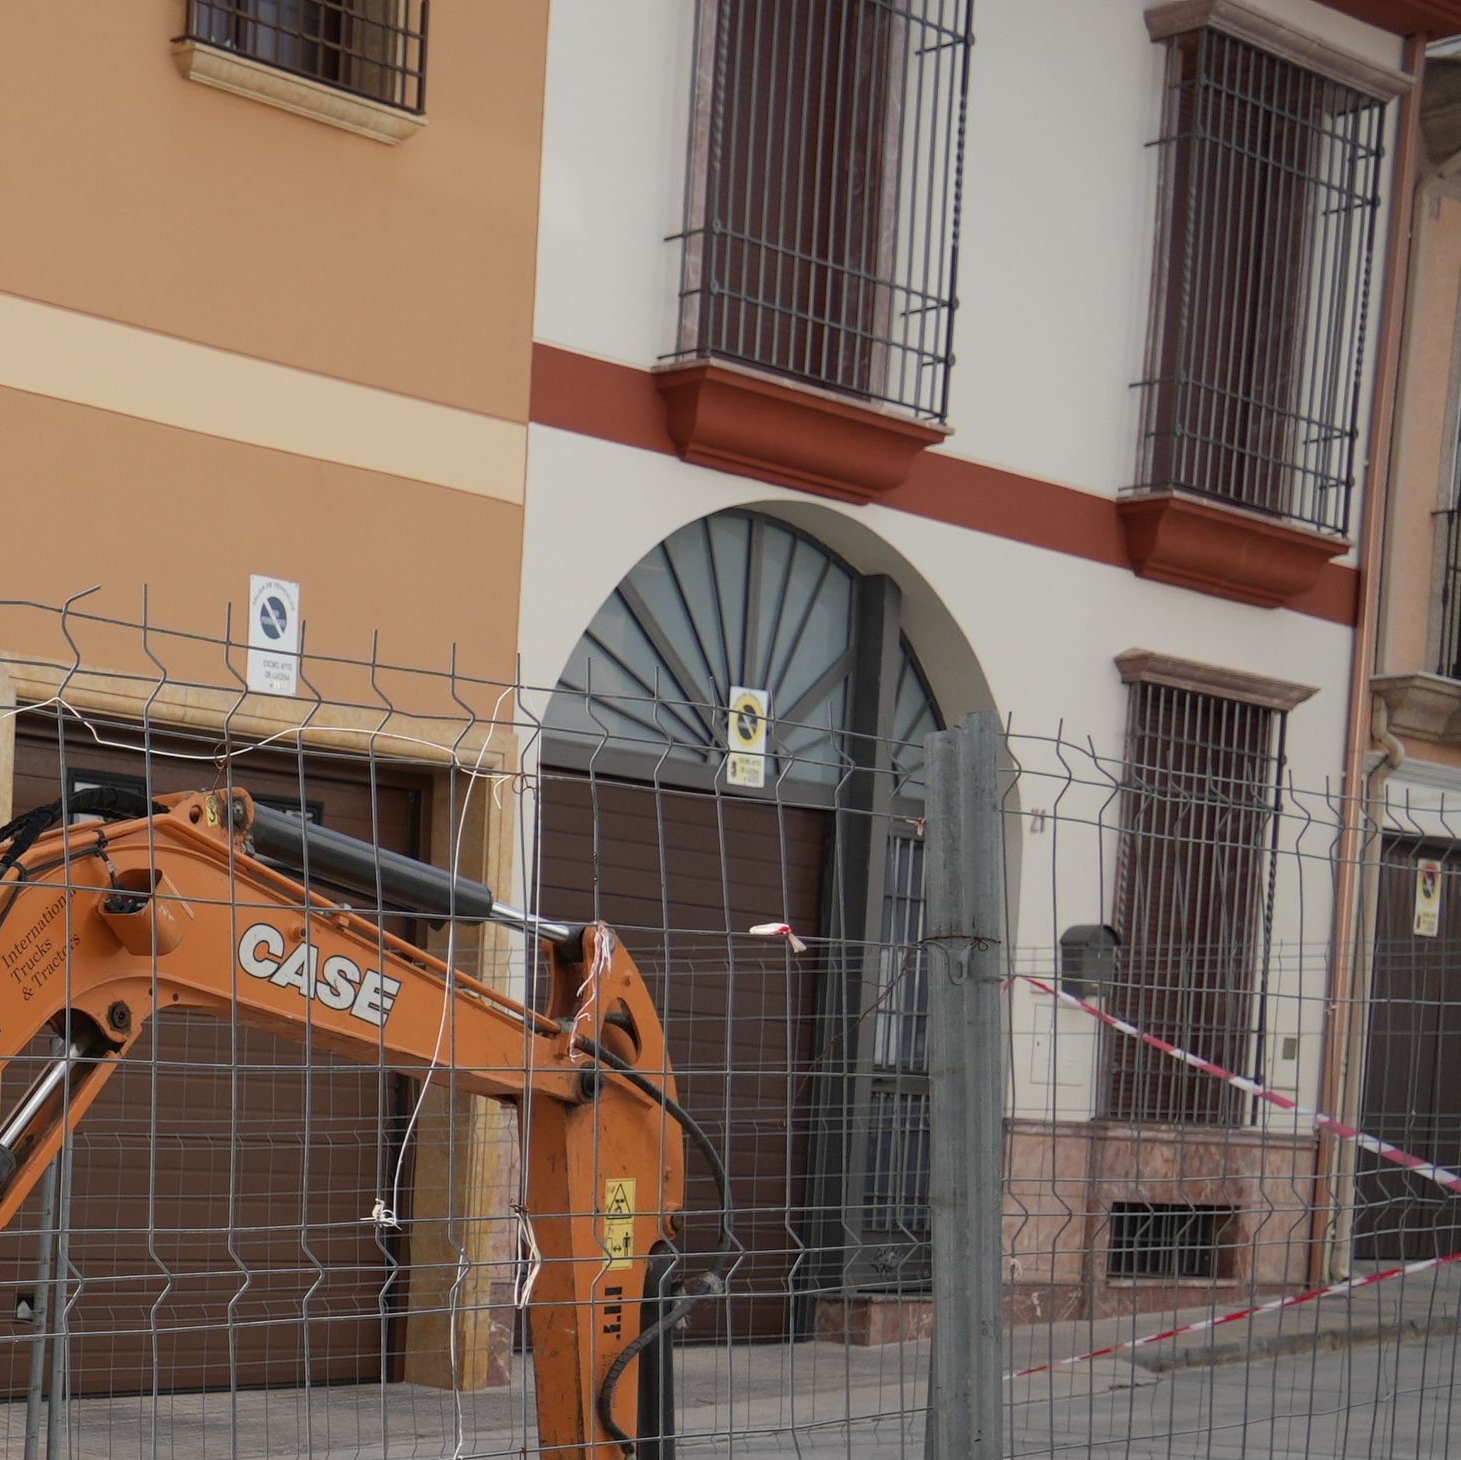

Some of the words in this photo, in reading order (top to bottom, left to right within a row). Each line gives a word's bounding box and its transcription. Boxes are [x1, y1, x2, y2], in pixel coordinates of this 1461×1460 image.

[1, 886, 77, 969] Internationa
[10, 939, 53, 984] Trucks
[21, 986, 35, 1001] &
[238, 922, 403, 1029] CASE
